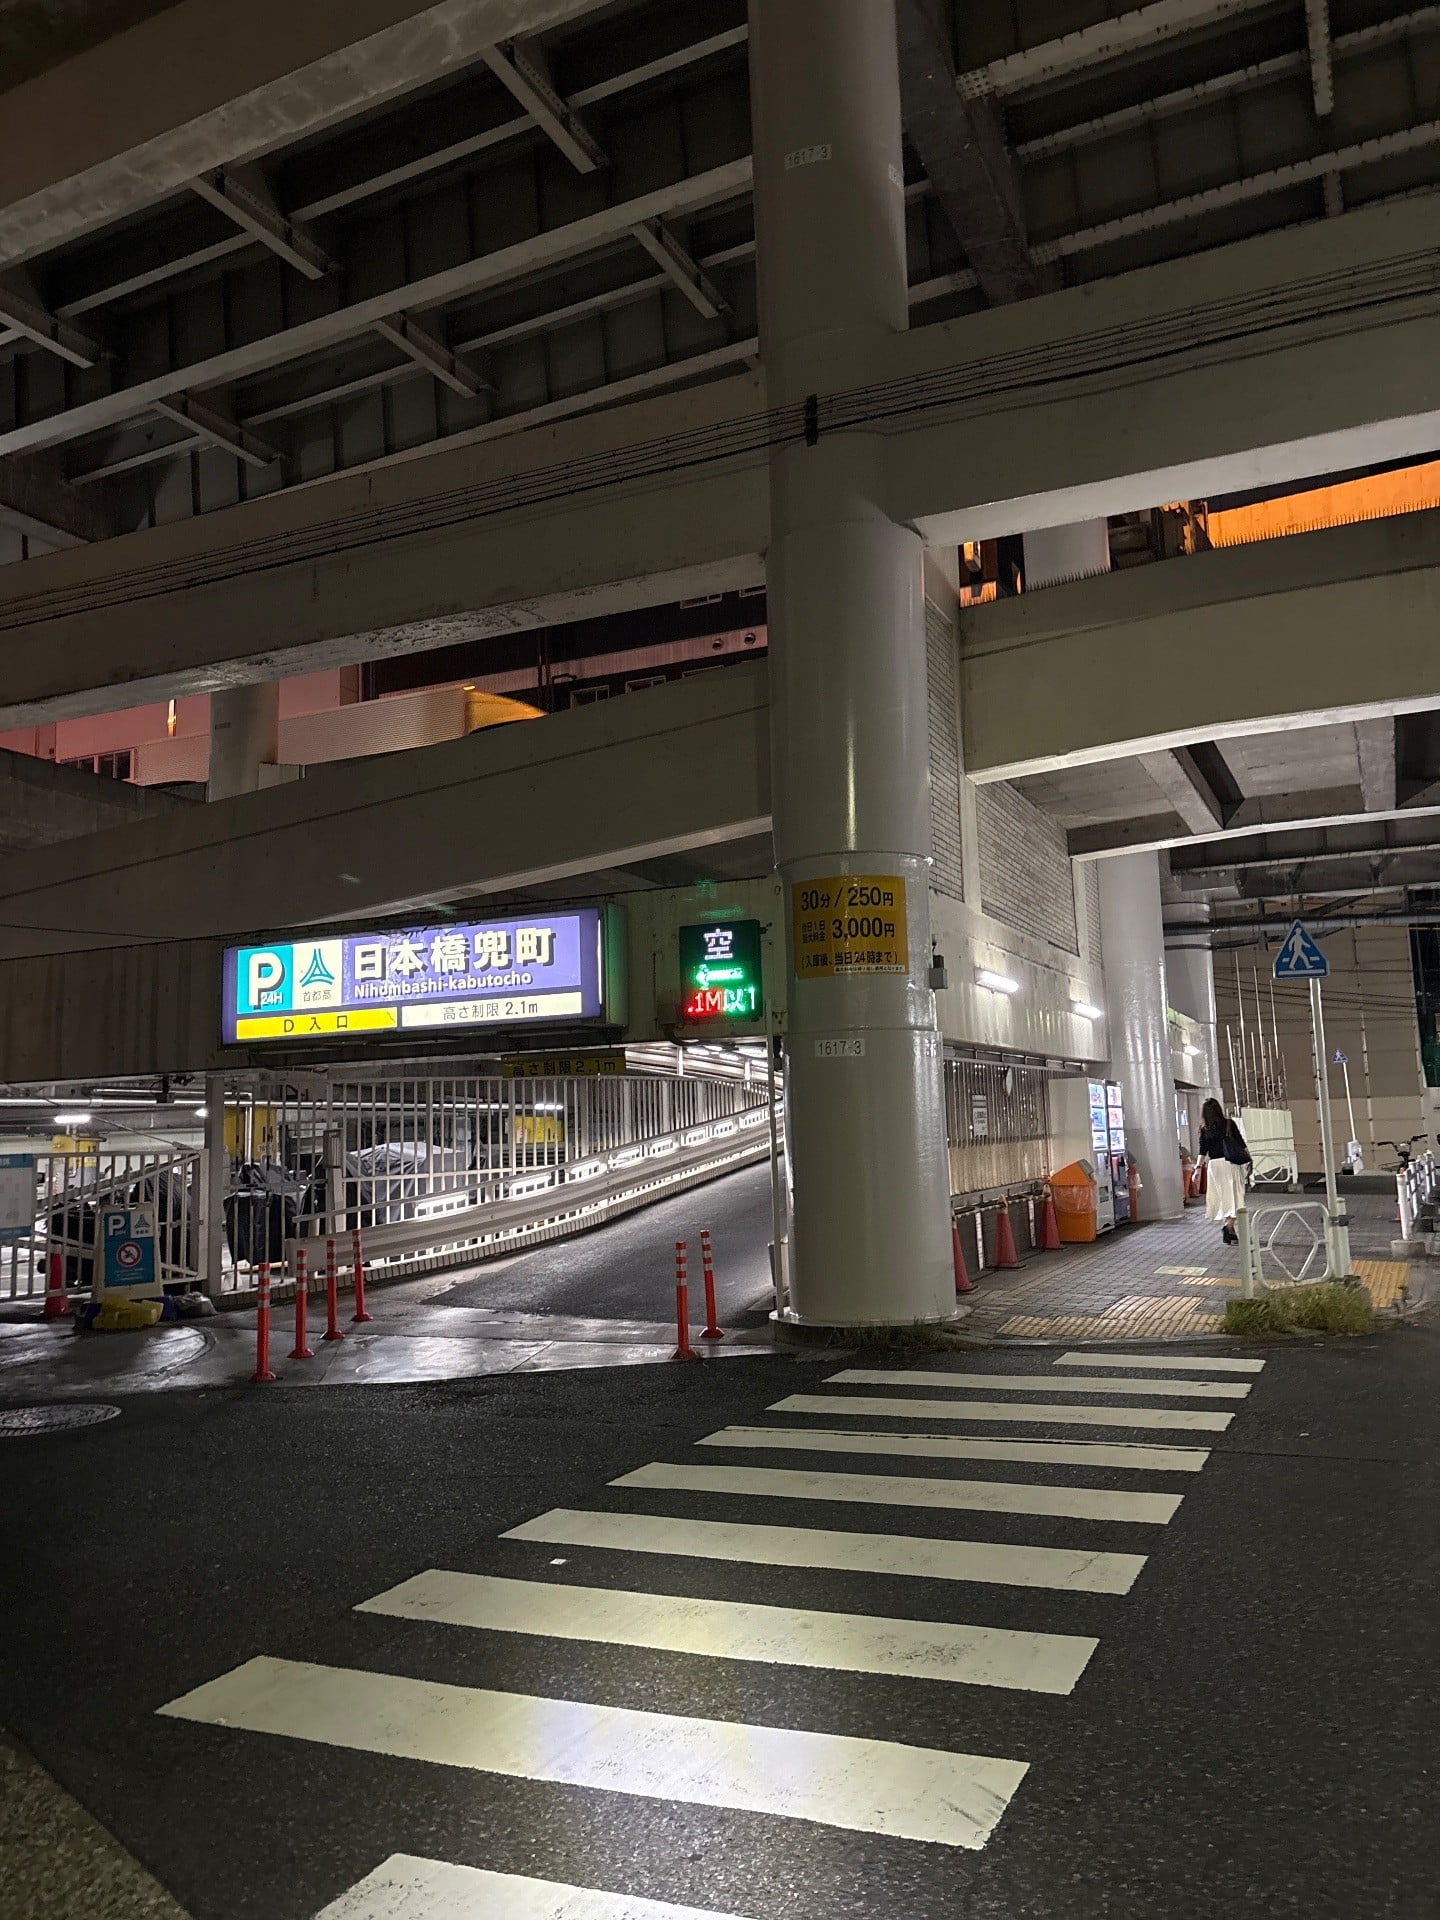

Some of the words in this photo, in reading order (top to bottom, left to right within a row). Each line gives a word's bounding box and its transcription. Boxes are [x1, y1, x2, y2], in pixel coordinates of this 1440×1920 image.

[832, 917, 895, 942] 3,000円
[354, 927, 556, 982] 日本橋兜町
[704, 928, 733, 960] 空
[249, 952, 285, 1010] P
[354, 970, 533, 998] Nihombashi-kabutocho
[261, 992, 283, 1005] 24H
[303, 990, 332, 1002] 首都高
[443, 1002, 499, 1021] 高さ制限
[505, 1000, 539, 1016] 2.1m
[819, 1041, 862, 1055] 1617-3
[108, 1215, 126, 1237] P
